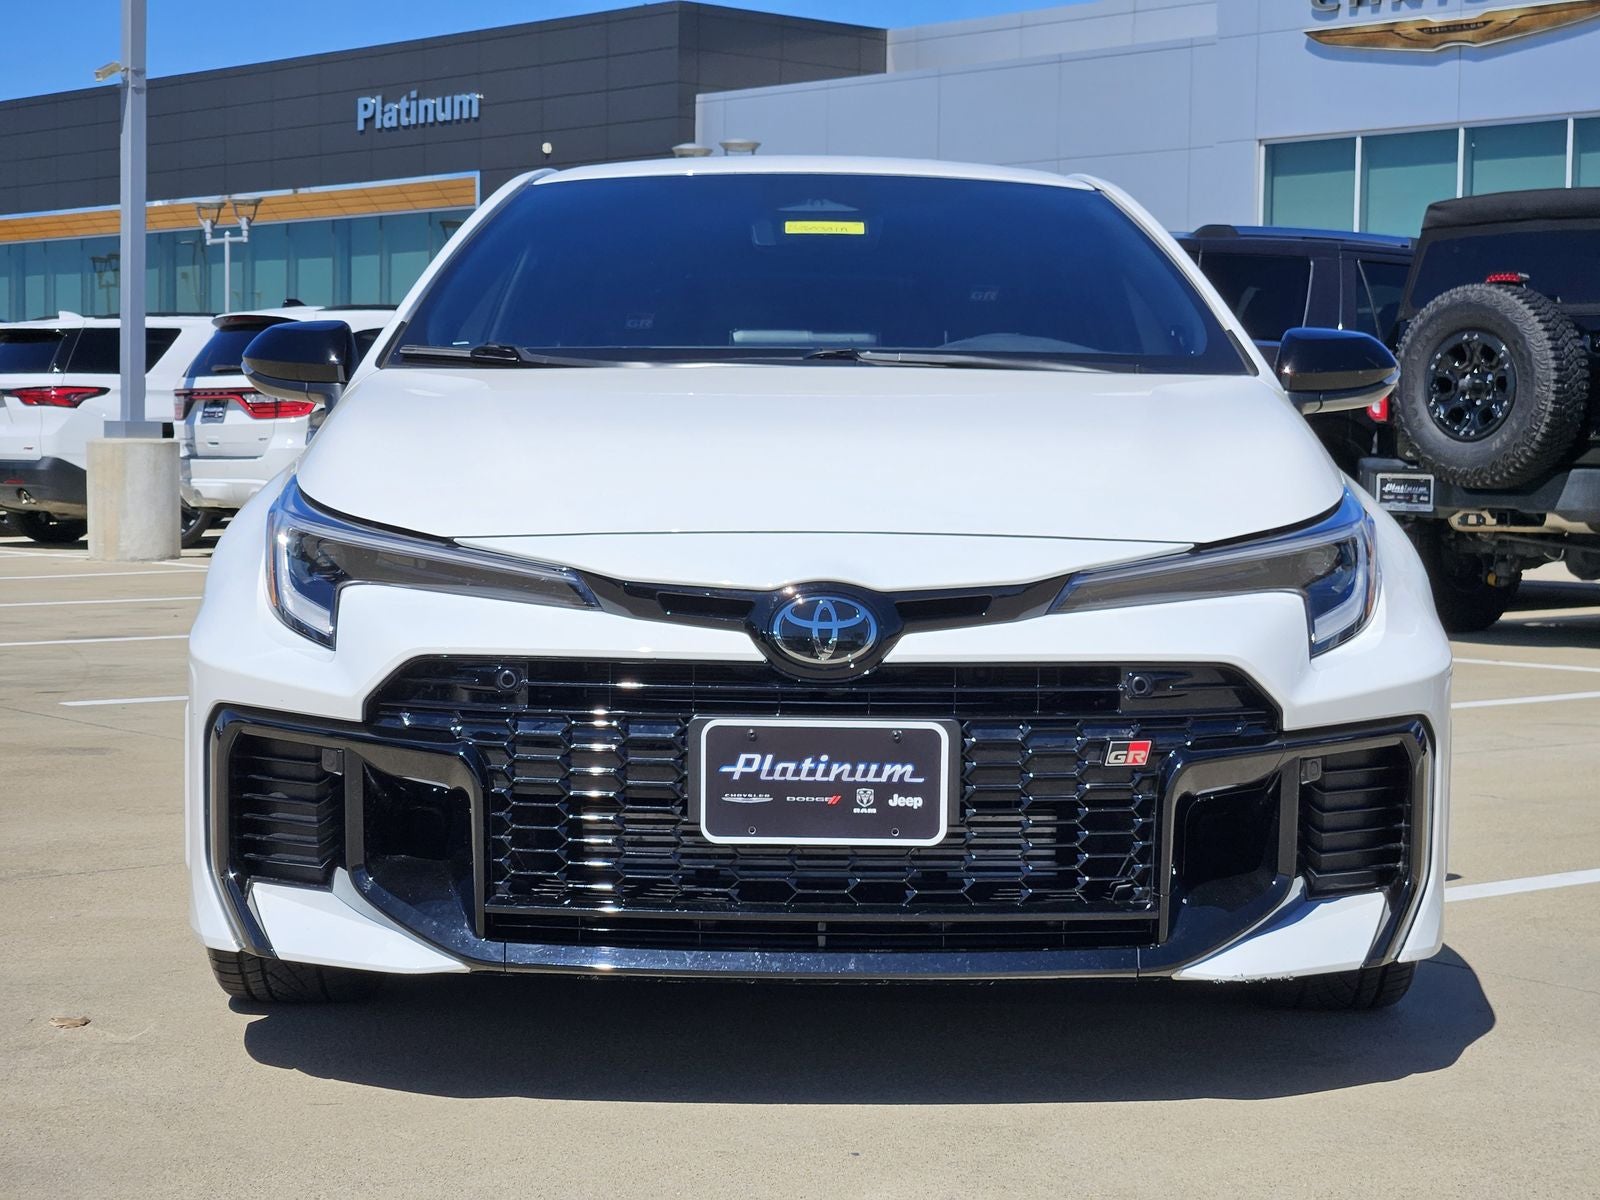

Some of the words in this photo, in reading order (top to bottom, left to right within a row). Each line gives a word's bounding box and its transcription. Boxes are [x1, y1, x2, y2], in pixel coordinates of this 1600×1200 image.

[356, 89, 481, 131] Platinum
[1382, 483, 1429, 494] Platinum
[1108, 750, 1147, 764] GR
[718, 753, 925, 782] Platinum
[888, 793, 923, 809] Jeep
